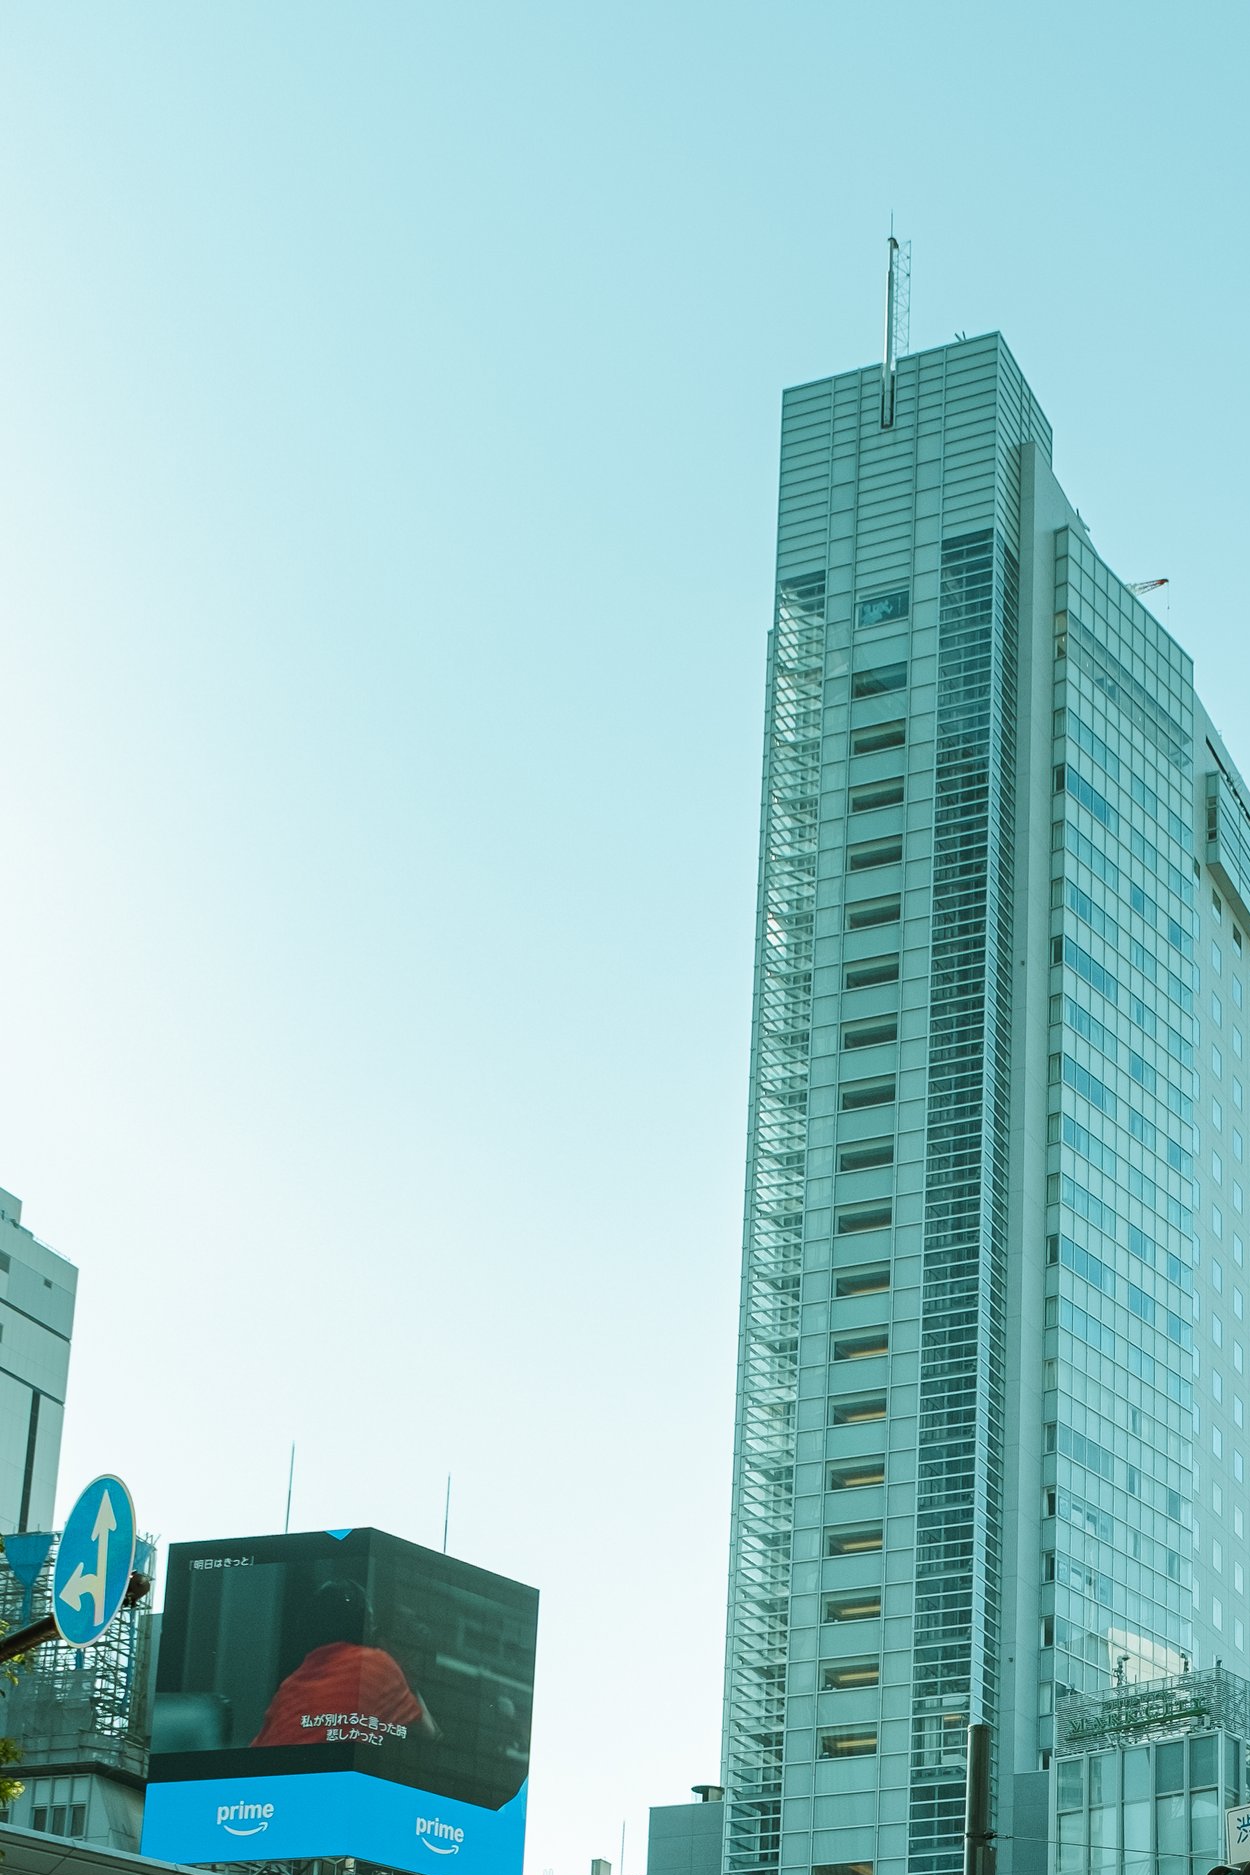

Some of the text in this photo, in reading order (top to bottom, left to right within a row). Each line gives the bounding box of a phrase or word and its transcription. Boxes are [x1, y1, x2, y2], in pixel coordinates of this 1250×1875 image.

[301, 1712, 407, 1739] 私が別れると言った時
[216, 1801, 275, 1824] prime
[415, 1816, 465, 1844] prime
